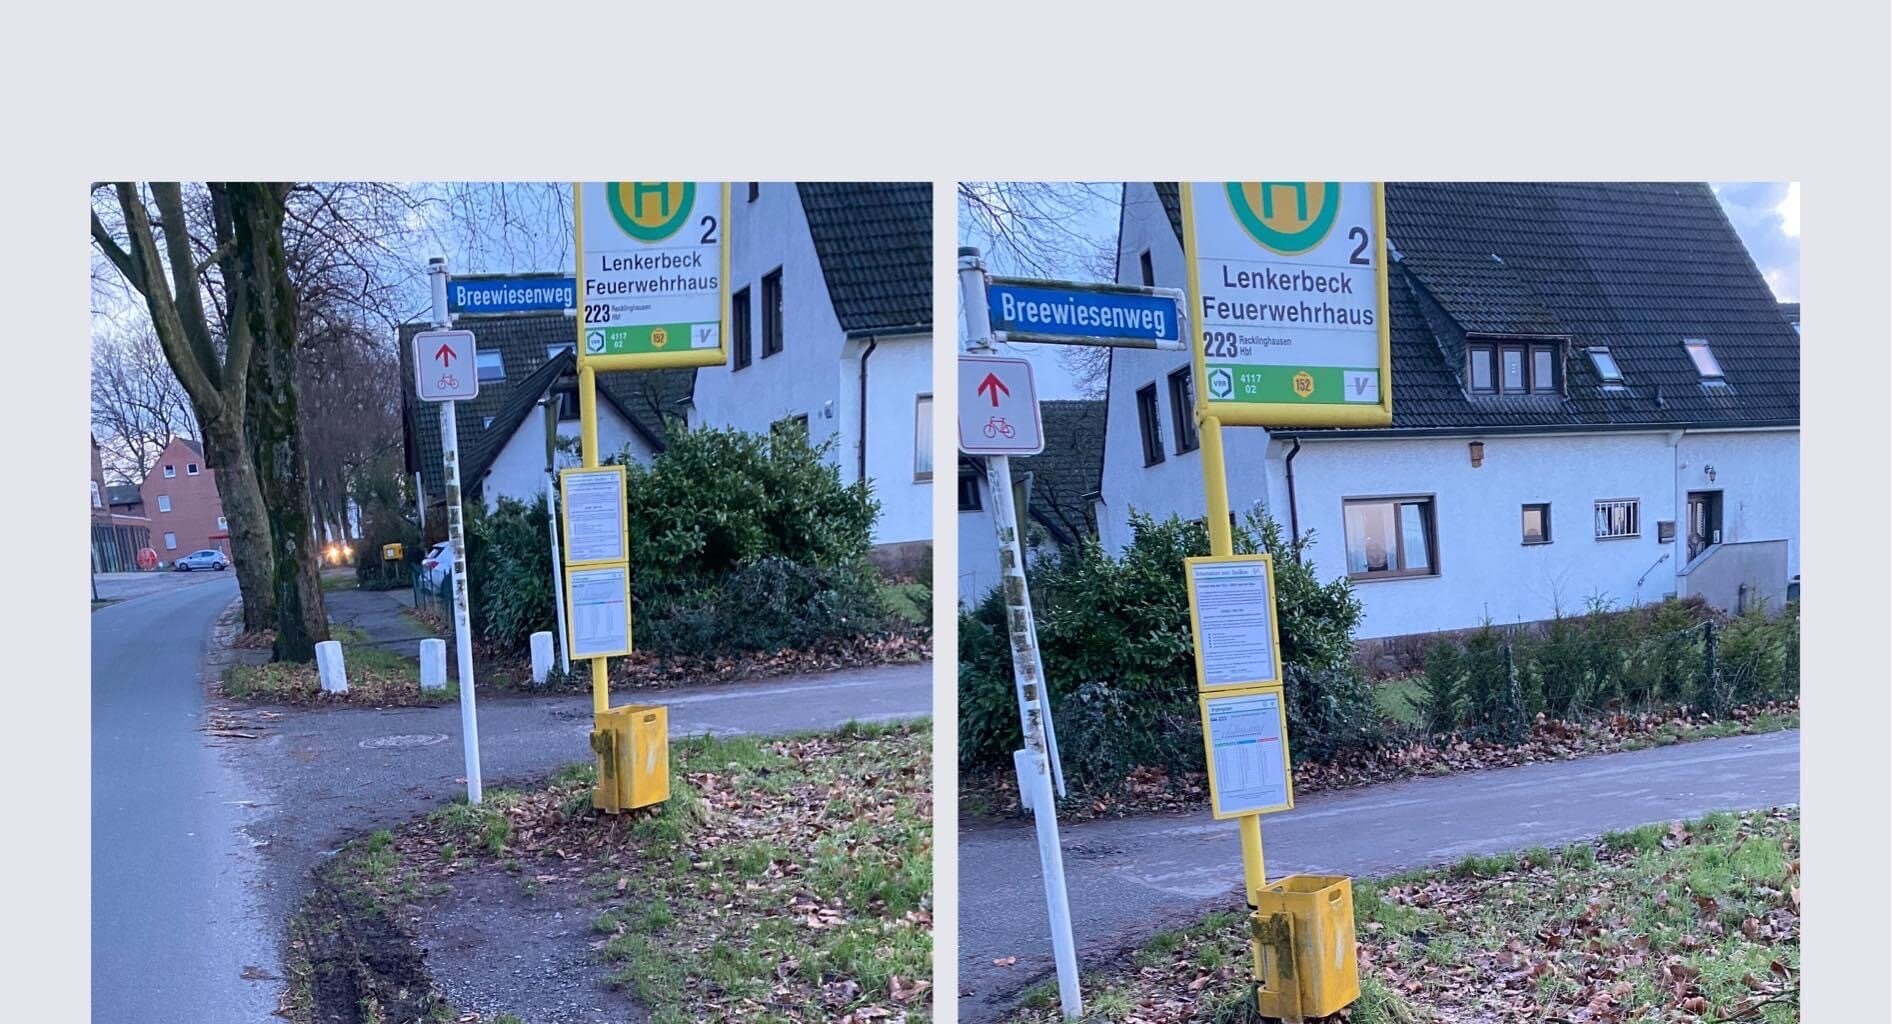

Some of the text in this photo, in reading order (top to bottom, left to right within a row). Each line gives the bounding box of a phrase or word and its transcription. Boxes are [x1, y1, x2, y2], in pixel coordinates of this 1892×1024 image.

[700, 215, 717, 244] 2
[1348, 226, 1370, 265] 2
[602, 251, 702, 272] Lenkerbeck
[586, 274, 719, 296] Feuerwehrhaus
[1223, 264, 1353, 294] Lenkerbeck
[456, 284, 573, 307] Breewiesenweg
[585, 304, 611, 323] 223
[1001, 292, 1166, 338] Breewiesenweg
[1202, 296, 1374, 326] Feuerwehrhaus
[611, 332, 627, 341] 4117
[1203, 331, 1238, 358] 223
[1239, 335, 1292, 347] Recklinghausen
[1239, 347, 1252, 356] Hbf
[1240, 373, 1261, 383] 4117
[1295, 378, 1311, 392] 152
[1245, 384, 1257, 394] 02
